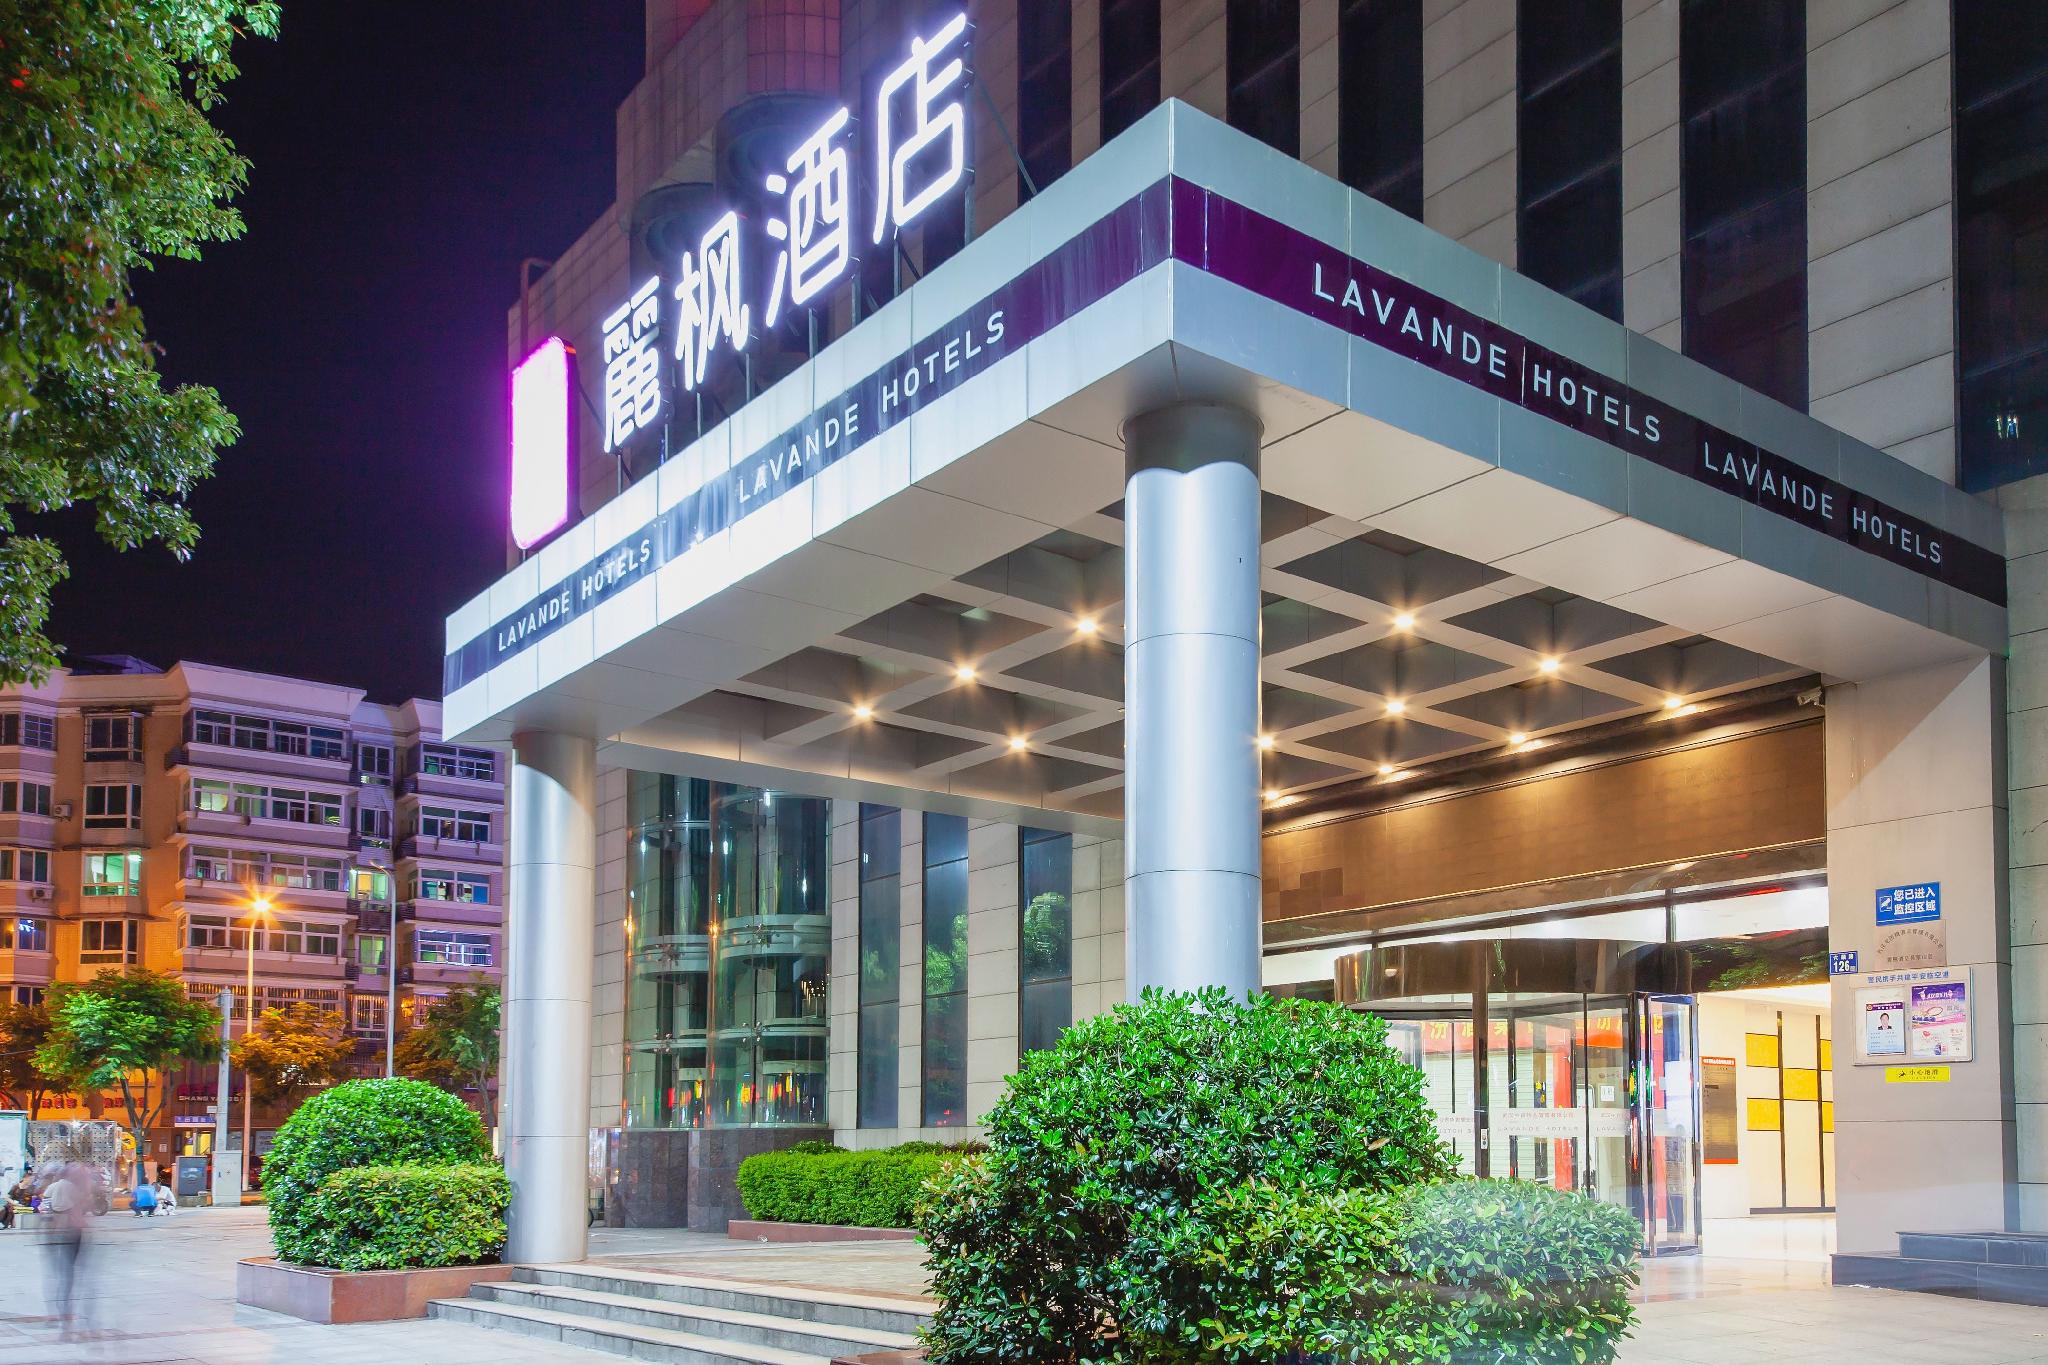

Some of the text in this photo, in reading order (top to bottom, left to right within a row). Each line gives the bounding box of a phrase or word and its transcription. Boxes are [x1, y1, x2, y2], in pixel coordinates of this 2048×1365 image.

[738, 310, 1005, 504] LAVANDE HOTELS
[1314, 262, 1661, 443] LAVANDE HOTELS
[1704, 441, 1942, 565] LAVANDE HOTELS
[498, 538, 652, 653] LAVANDE HOTELS
[1893, 886, 1936, 901] 您已进入
[1893, 899, 1936, 915] 监控区域
[1833, 960, 1850, 973] 126
